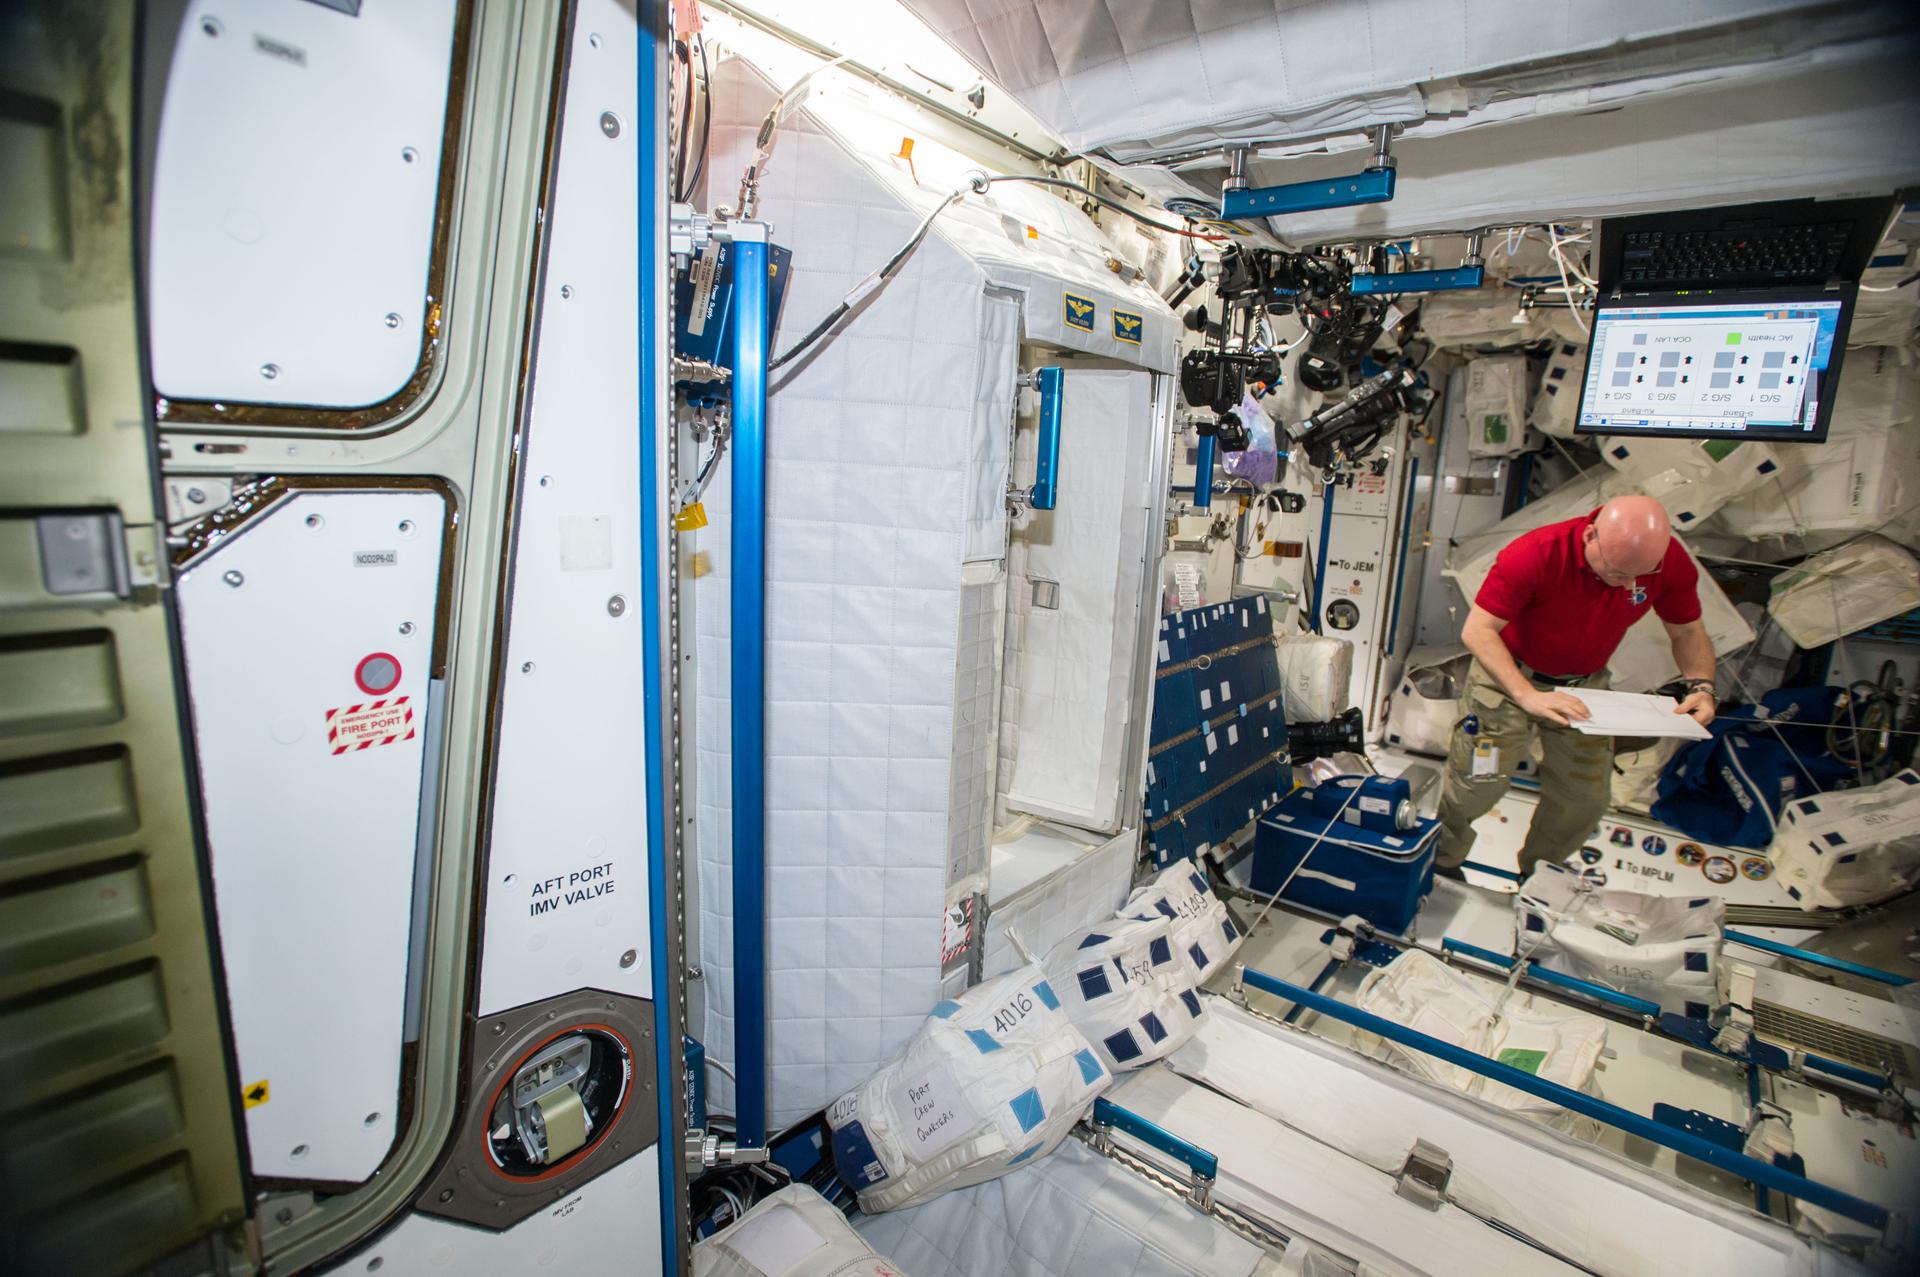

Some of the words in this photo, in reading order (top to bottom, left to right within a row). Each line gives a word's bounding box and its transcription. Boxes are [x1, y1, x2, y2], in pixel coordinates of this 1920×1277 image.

[1613, 392, 1632, 400] S/G
[1657, 393, 1677, 401] S/G
[1701, 393, 1708, 402] 2
[1711, 394, 1732, 402] S/G
[1760, 394, 1782, 403] S/G
[1339, 560, 1351, 570] To
[1353, 561, 1375, 572] JEM
[341, 723, 367, 735] FIRE
[371, 717, 401, 729] PORT
[1626, 861, 1638, 874] To
[1641, 865, 1675, 883] MPLM
[531, 876, 564, 897] AFT
[570, 862, 613, 886] PORT
[530, 896, 560, 917] IMV
[564, 880, 615, 905] VALVE
[994, 993, 1033, 1033] 4016
[561, 1206, 574, 1217] LAB
